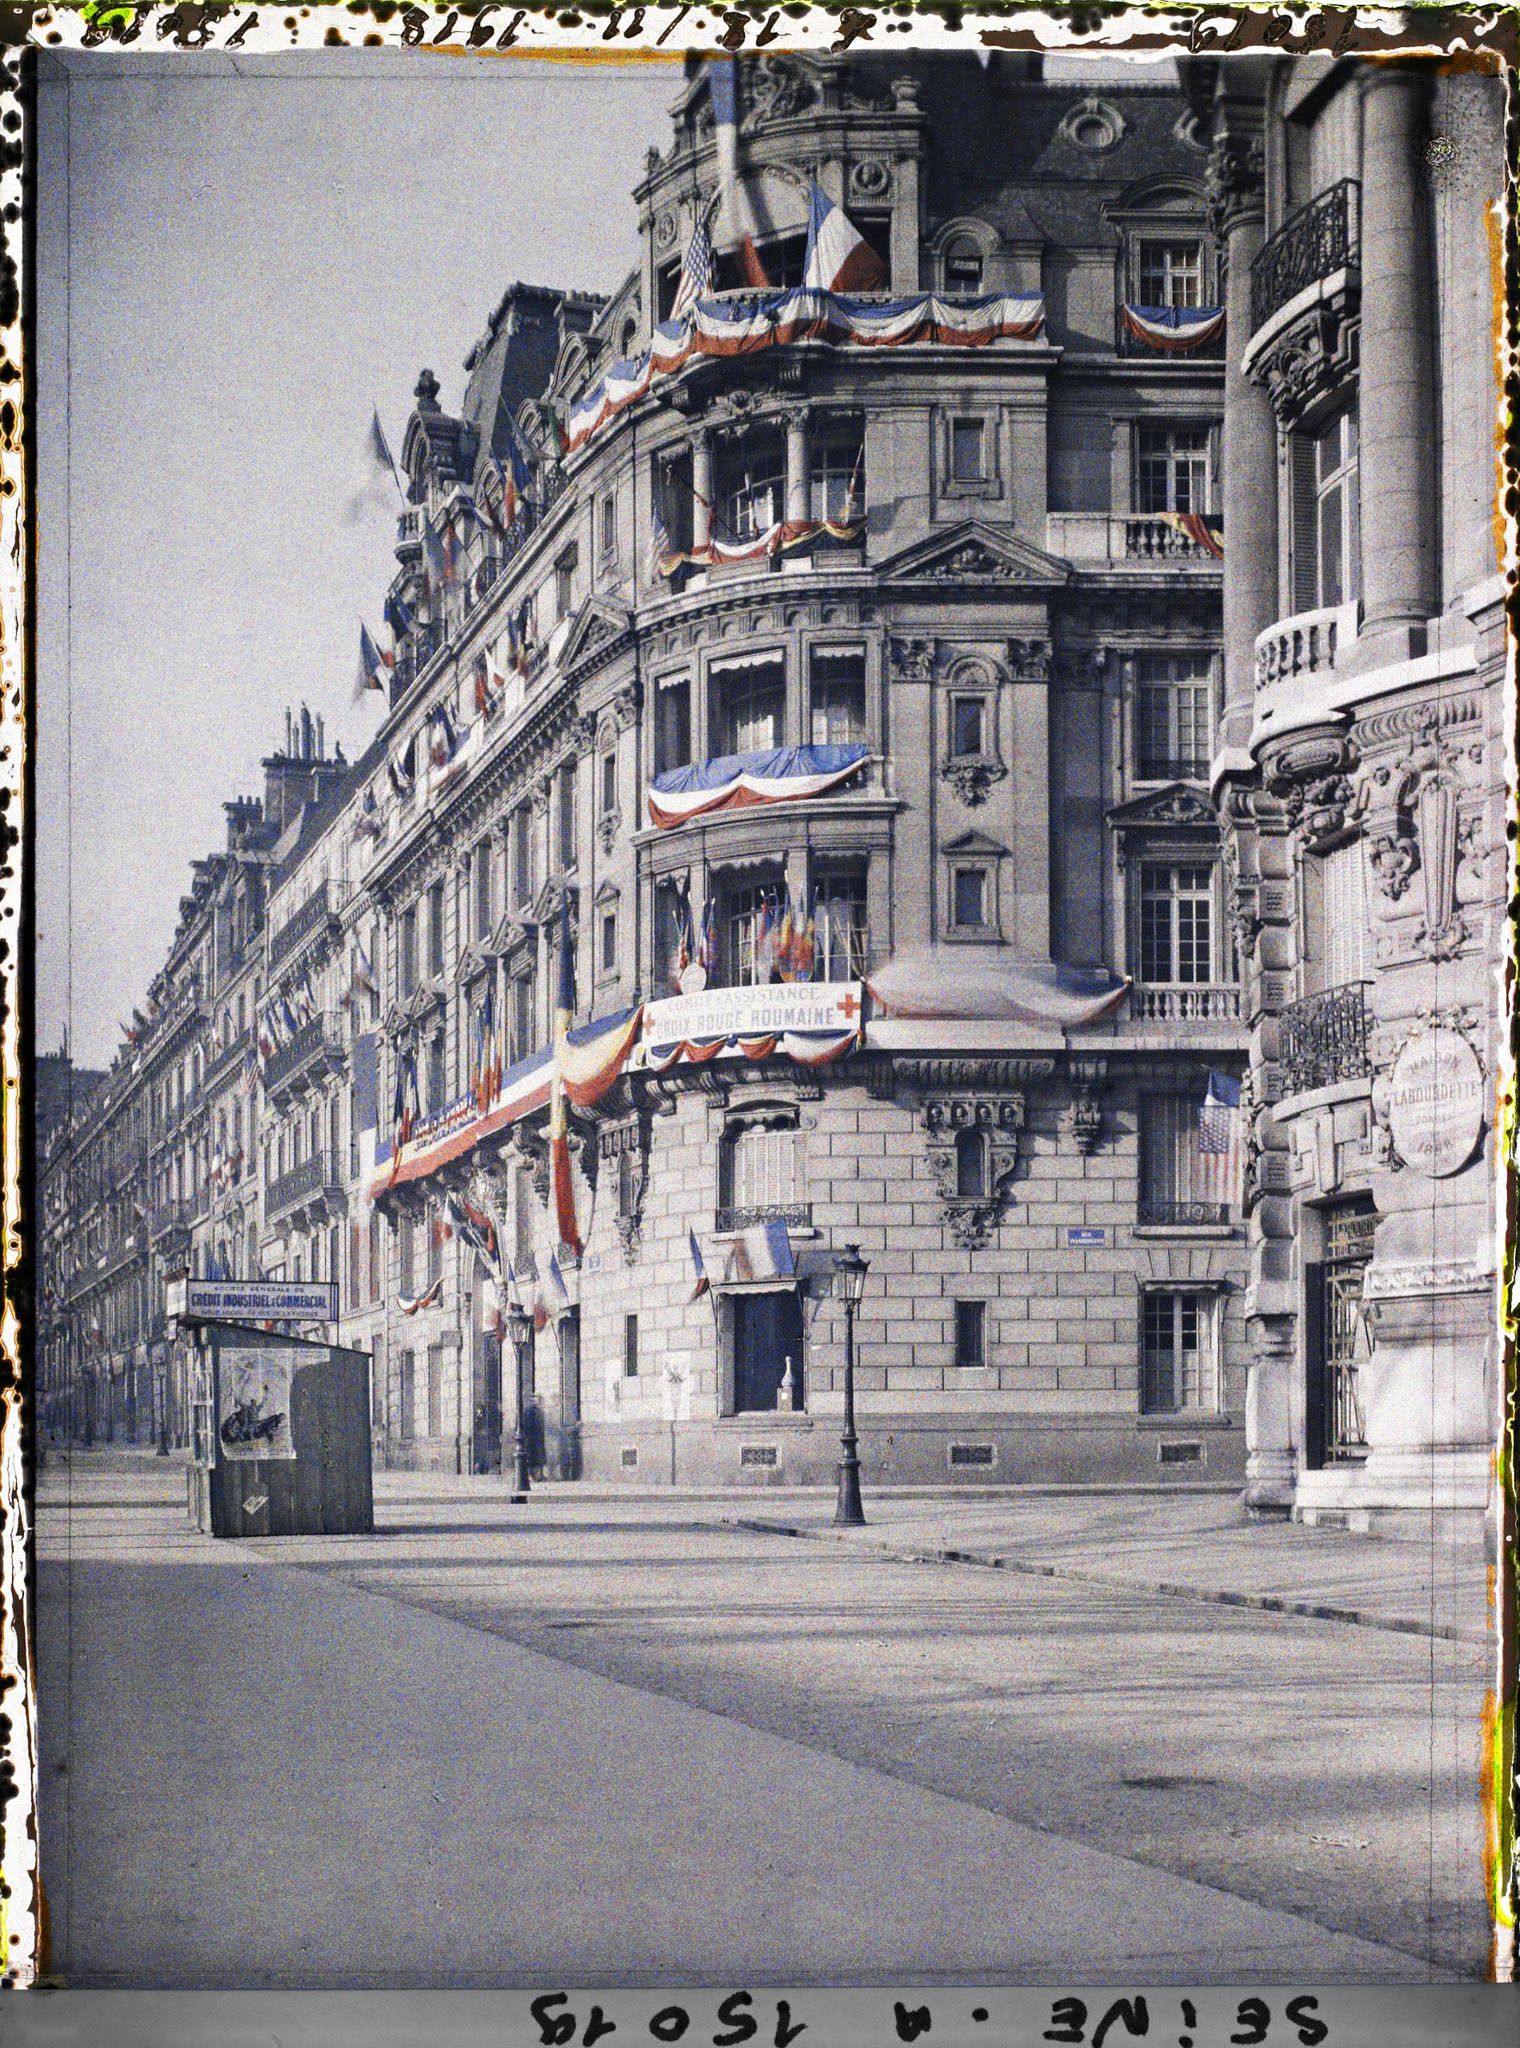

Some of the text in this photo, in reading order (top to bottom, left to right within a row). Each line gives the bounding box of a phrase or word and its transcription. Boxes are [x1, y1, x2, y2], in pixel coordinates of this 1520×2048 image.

[751, 1007, 834, 1026] ROUMAINE
[223, 1293, 270, 1307] INDUSTRIEL
[276, 1294, 327, 1308] COMMERCIAL
[531, 1991, 808, 2048] 15019
